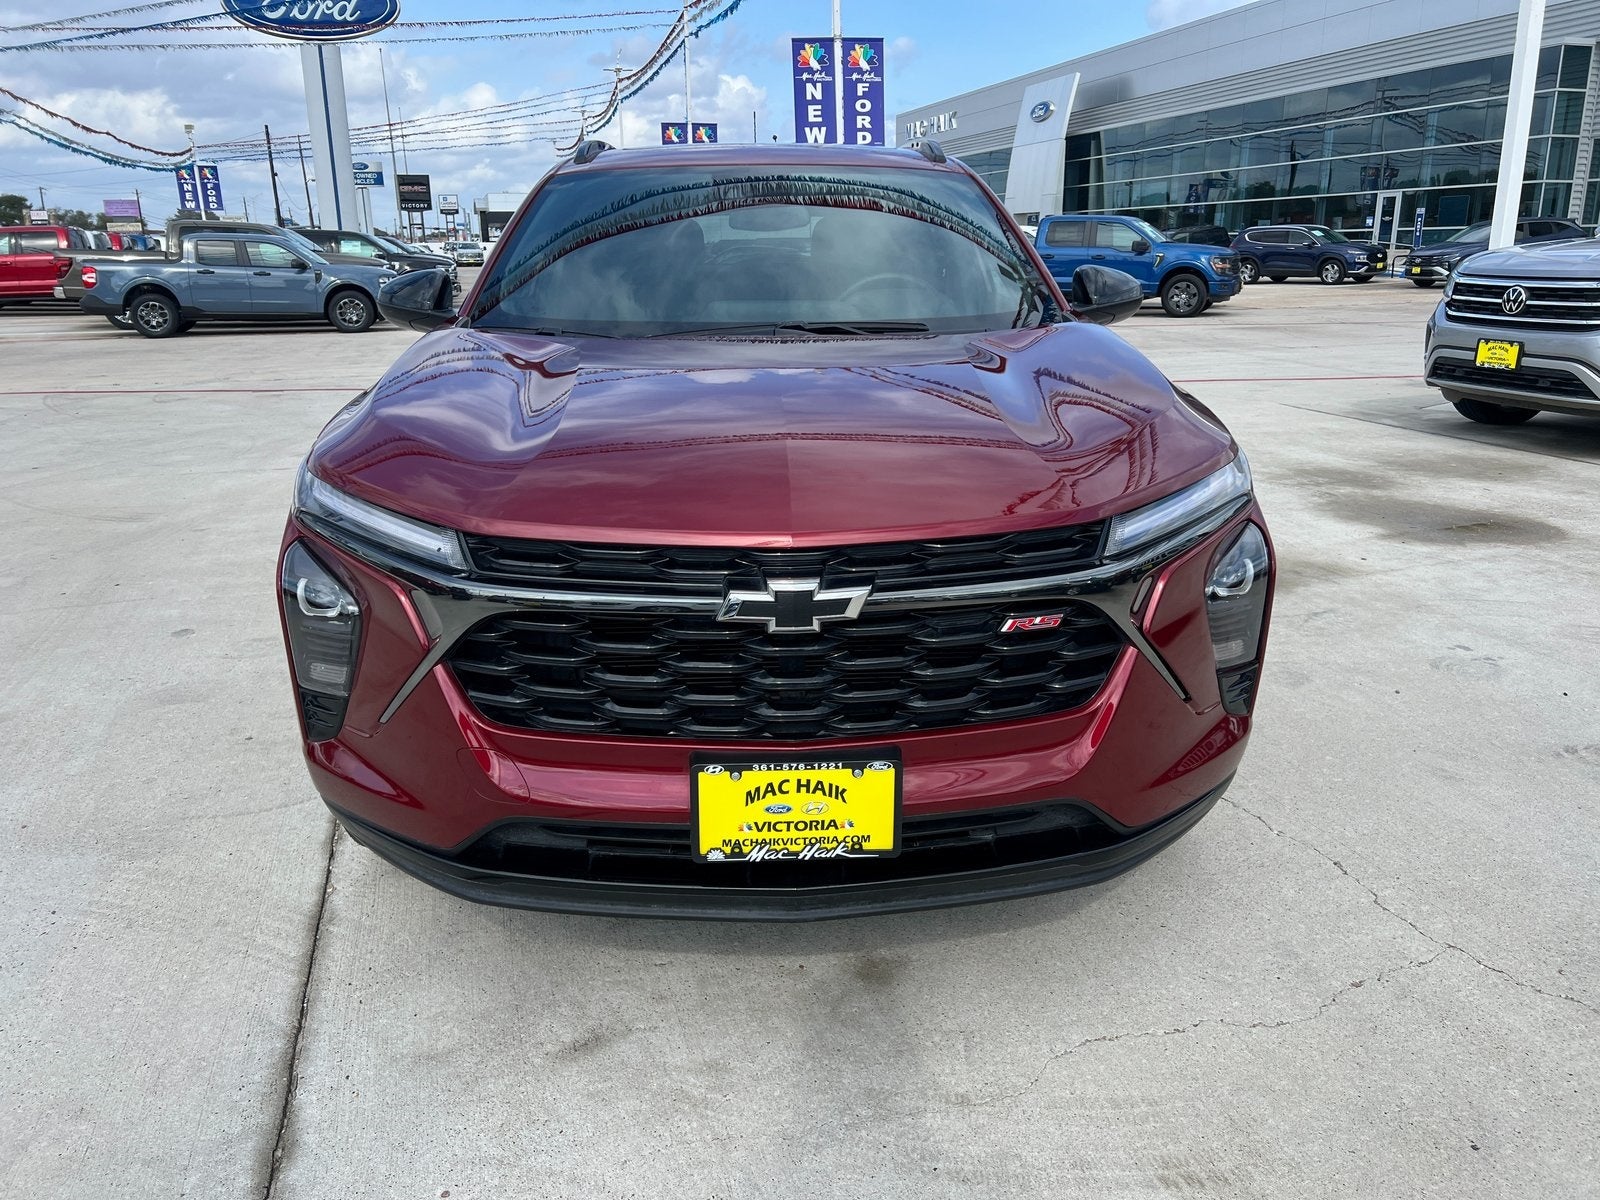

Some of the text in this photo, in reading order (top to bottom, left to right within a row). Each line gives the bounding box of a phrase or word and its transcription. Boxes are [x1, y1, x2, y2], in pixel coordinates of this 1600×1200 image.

[804, 83, 826, 144] NEW
[855, 83, 872, 145] FORD
[905, 111, 957, 140] MAC HAIK
[183, 183, 195, 209] NEW
[207, 183, 217, 209] FORD
[1000, 614, 1063, 632] RS
[752, 762, 843, 771] 361-576-1221
[745, 778, 847, 806] MAC HAIK
[753, 819, 839, 833] VICTORIA
[722, 834, 871, 848] MACHAIKVICTORIA.COM
[746, 841, 853, 862] Mac Haik
